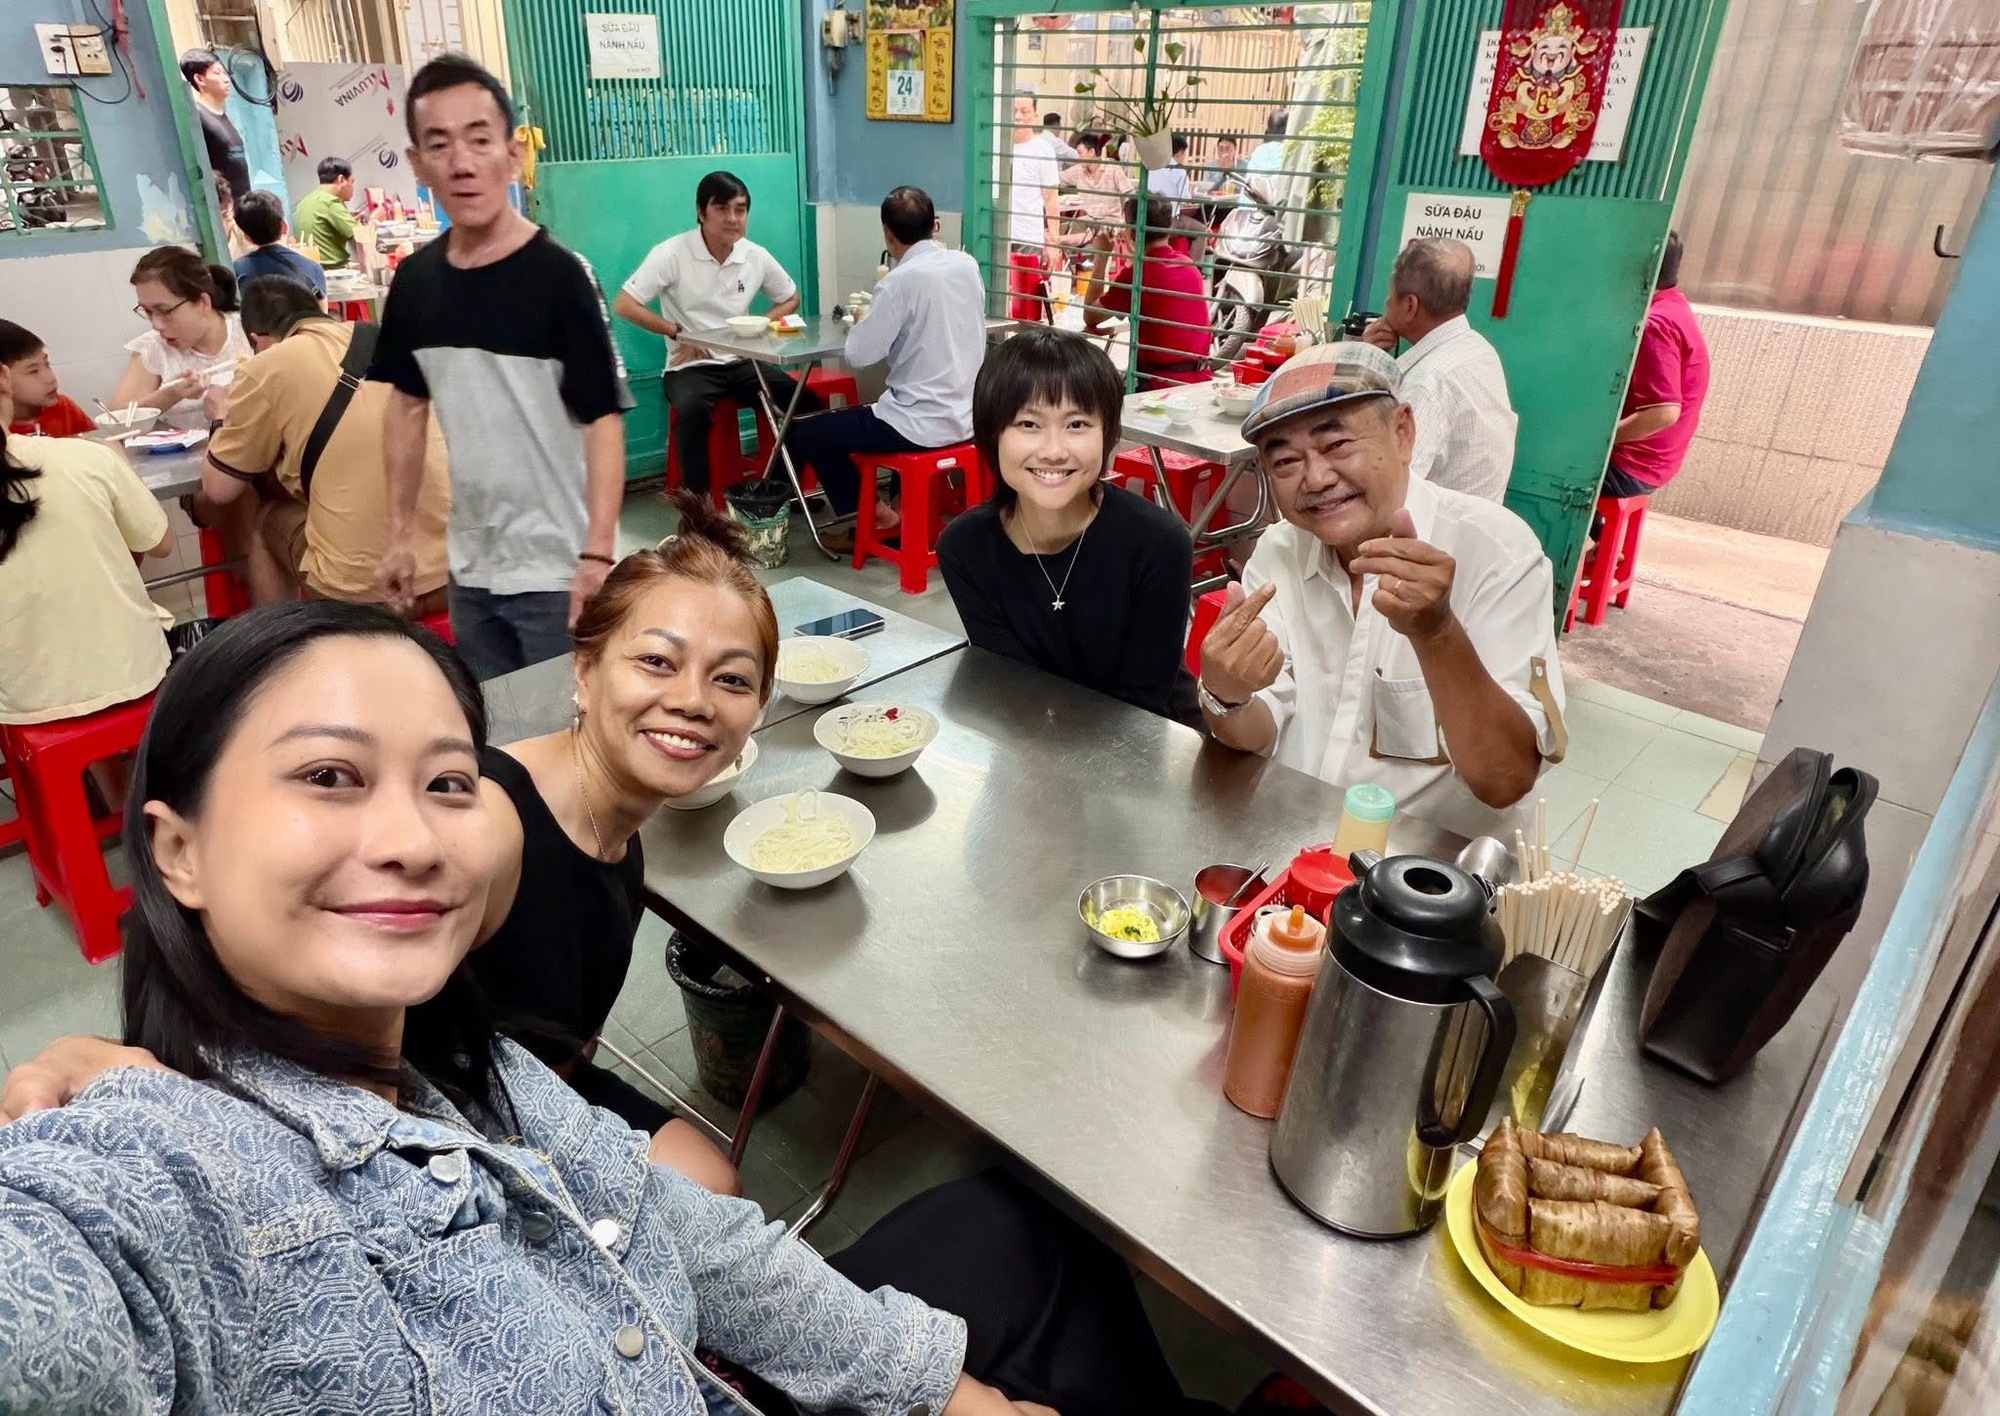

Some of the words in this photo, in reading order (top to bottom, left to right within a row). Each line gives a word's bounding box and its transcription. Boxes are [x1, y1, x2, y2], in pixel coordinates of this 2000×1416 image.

[334, 67, 390, 107] ALUVINA
[897, 75, 912, 96] 24
[1425, 204, 1450, 218] SỮA
[1454, 205, 1482, 222] ĐẬU
[1416, 224, 1453, 239] NÀNH
[1456, 226, 1484, 241] NẤU
